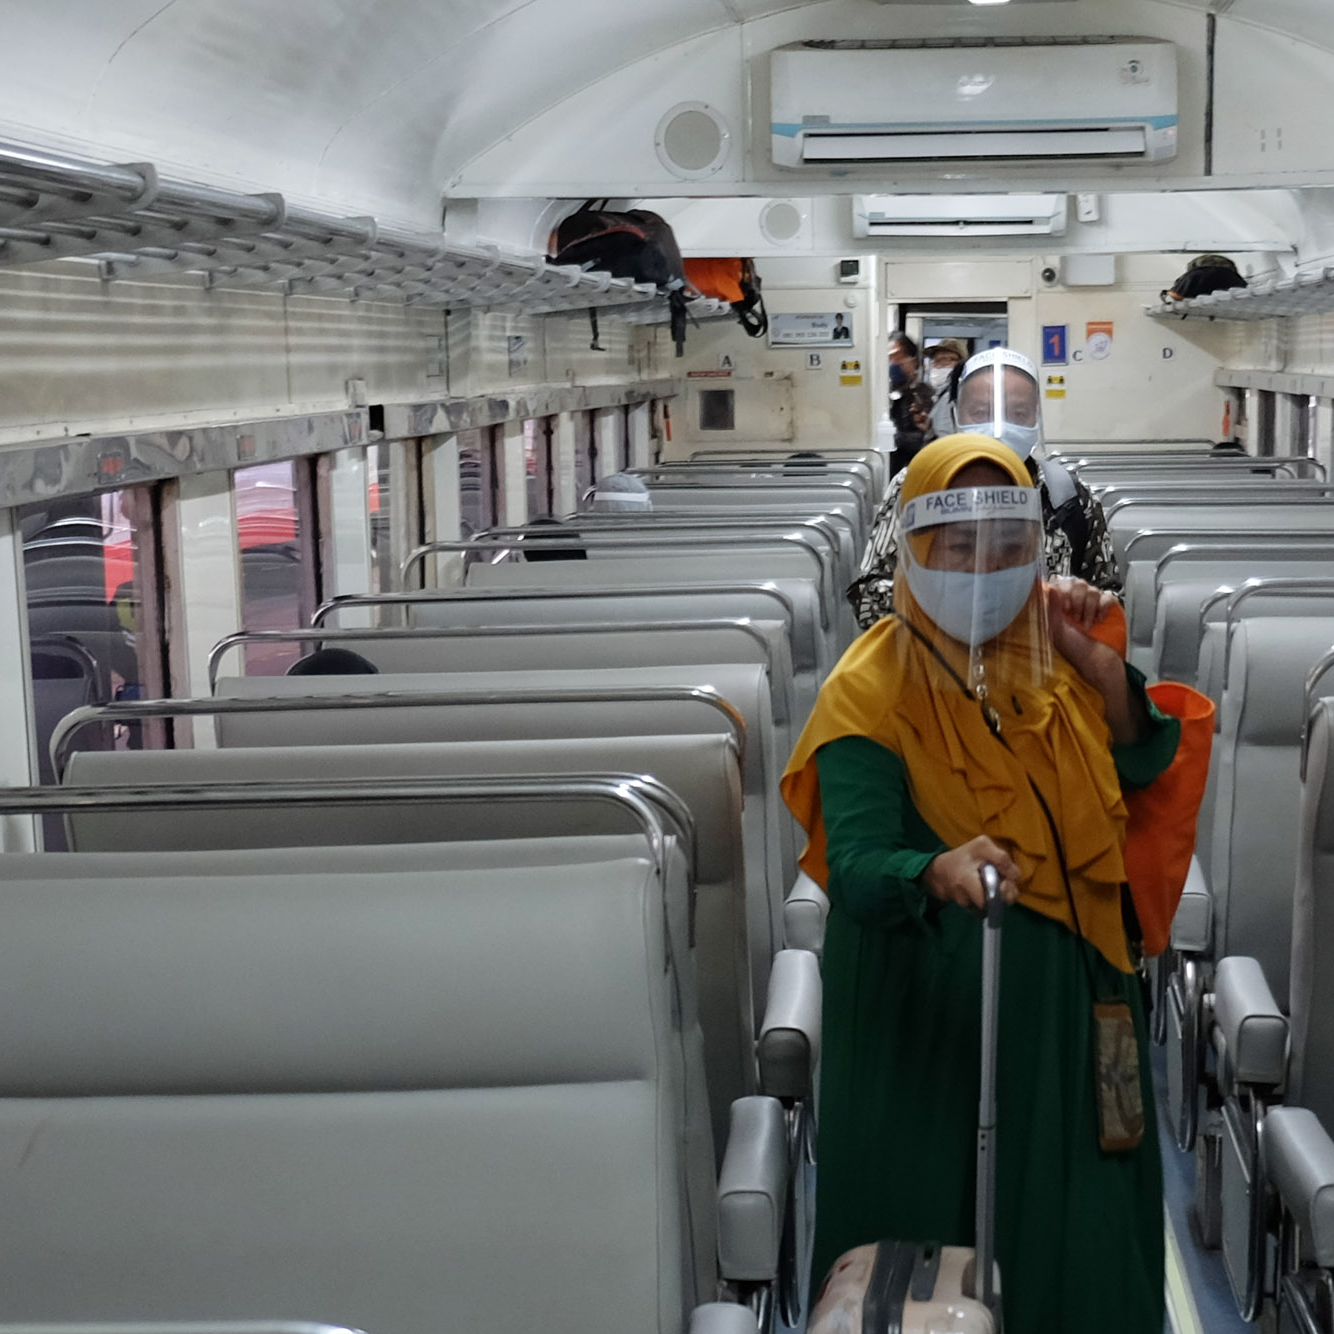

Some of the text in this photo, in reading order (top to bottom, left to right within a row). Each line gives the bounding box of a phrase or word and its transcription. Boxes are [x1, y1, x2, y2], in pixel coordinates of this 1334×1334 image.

[1049, 333, 1061, 356] 1
[809, 353, 821, 366] B
[1072, 349, 1083, 361] C
[1162, 347, 1174, 359] D
[722, 354, 732, 367] A
[925, 491, 966, 511] FACE
[972, 489, 1028, 506] SHIELD
